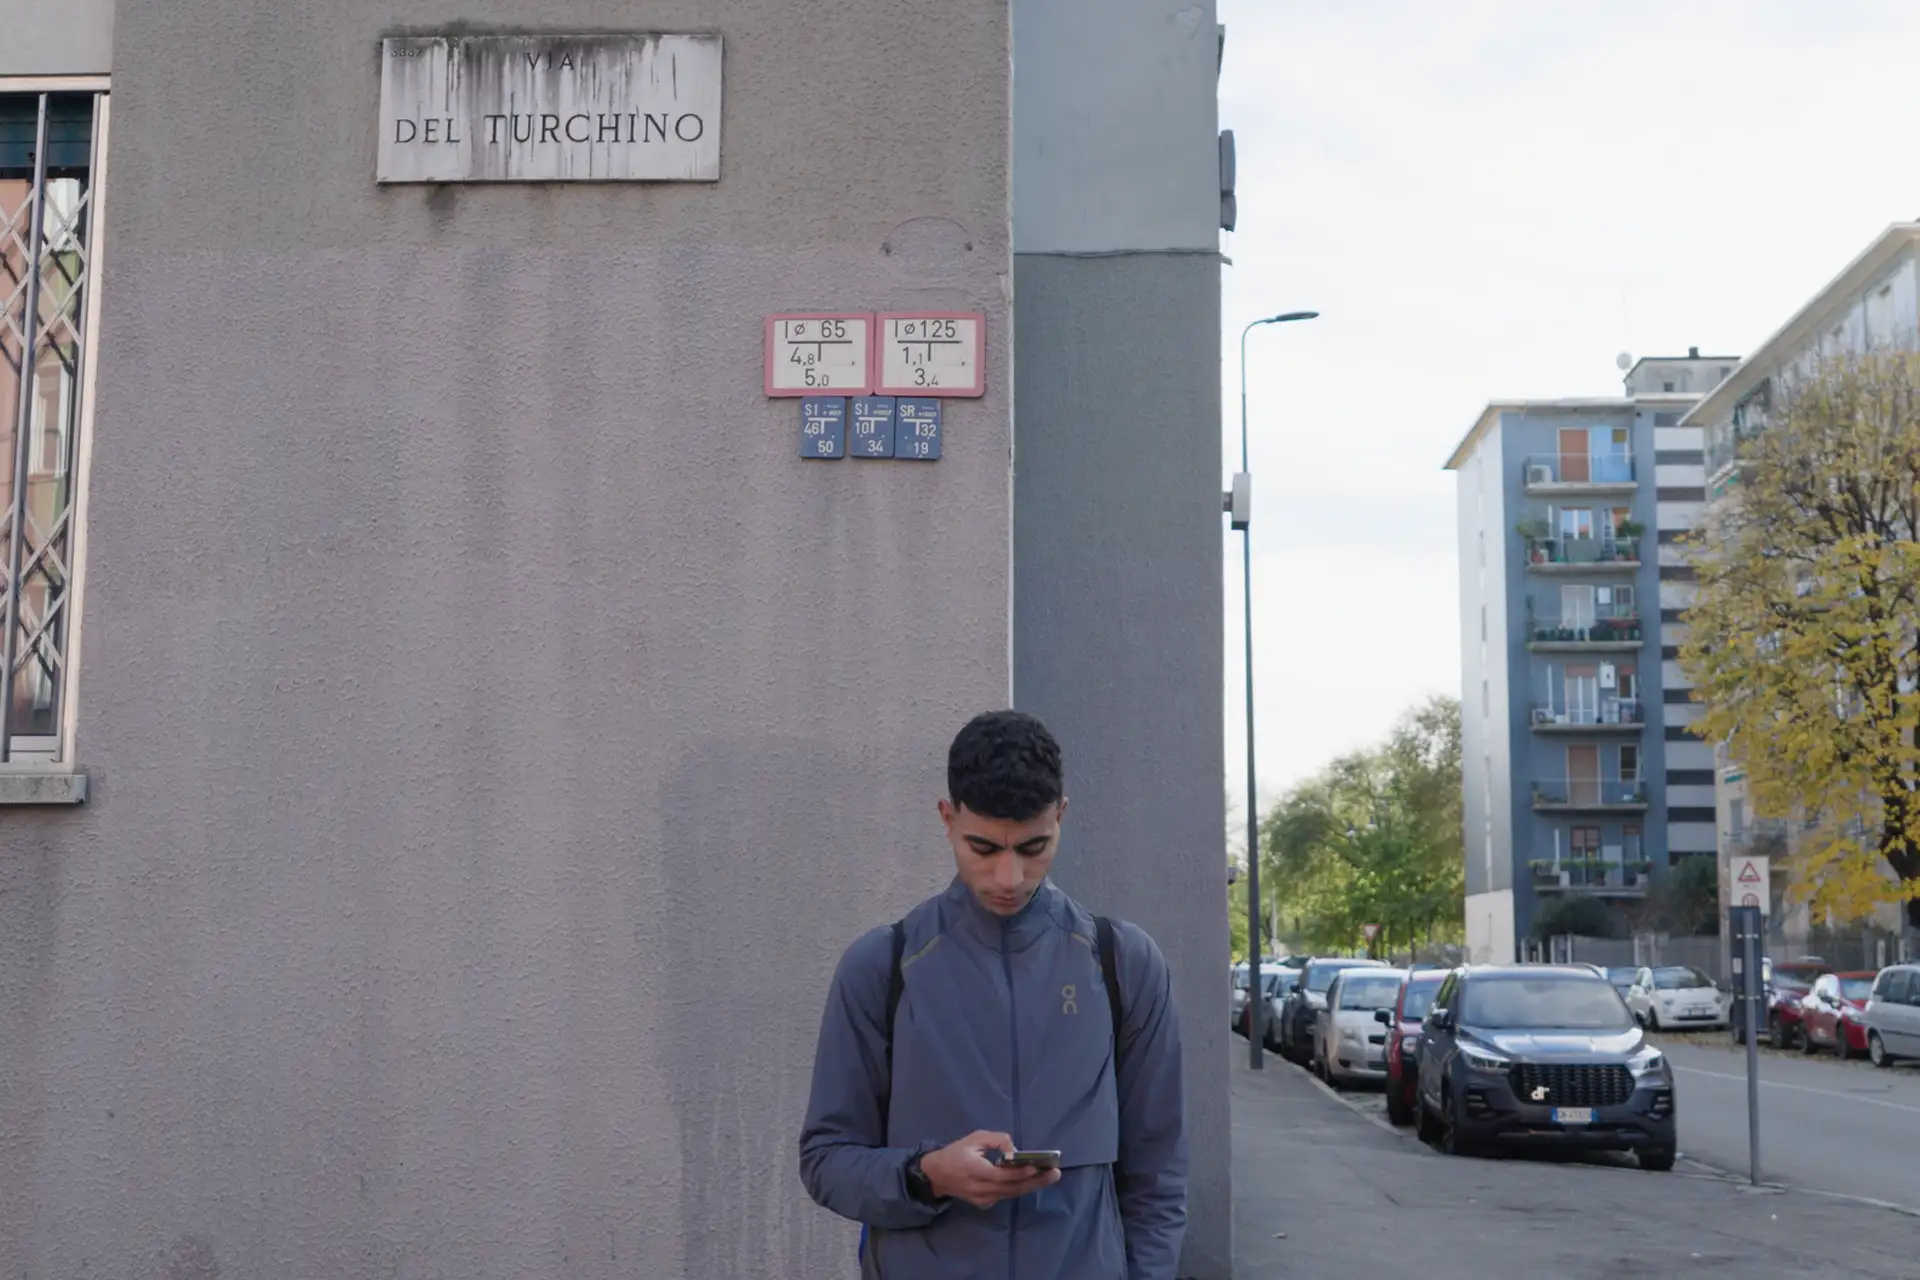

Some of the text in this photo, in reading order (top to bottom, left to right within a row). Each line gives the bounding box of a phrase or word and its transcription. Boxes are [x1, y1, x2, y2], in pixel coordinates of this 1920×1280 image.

[524, 52, 575, 71] VIA
[393, 112, 705, 145] DEL TURCHINO
[821, 319, 846, 338] 65
[790, 346, 815, 366] 4,8
[804, 368, 830, 387] 5,0
[914, 368, 940, 387] 3,4
[899, 405, 916, 417] SR
[803, 422, 820, 435] 46
[855, 422, 869, 434] 10
[920, 424, 937, 437] 32
[817, 440, 834, 453] 50
[867, 440, 884, 452] 34
[914, 442, 929, 454] 19
